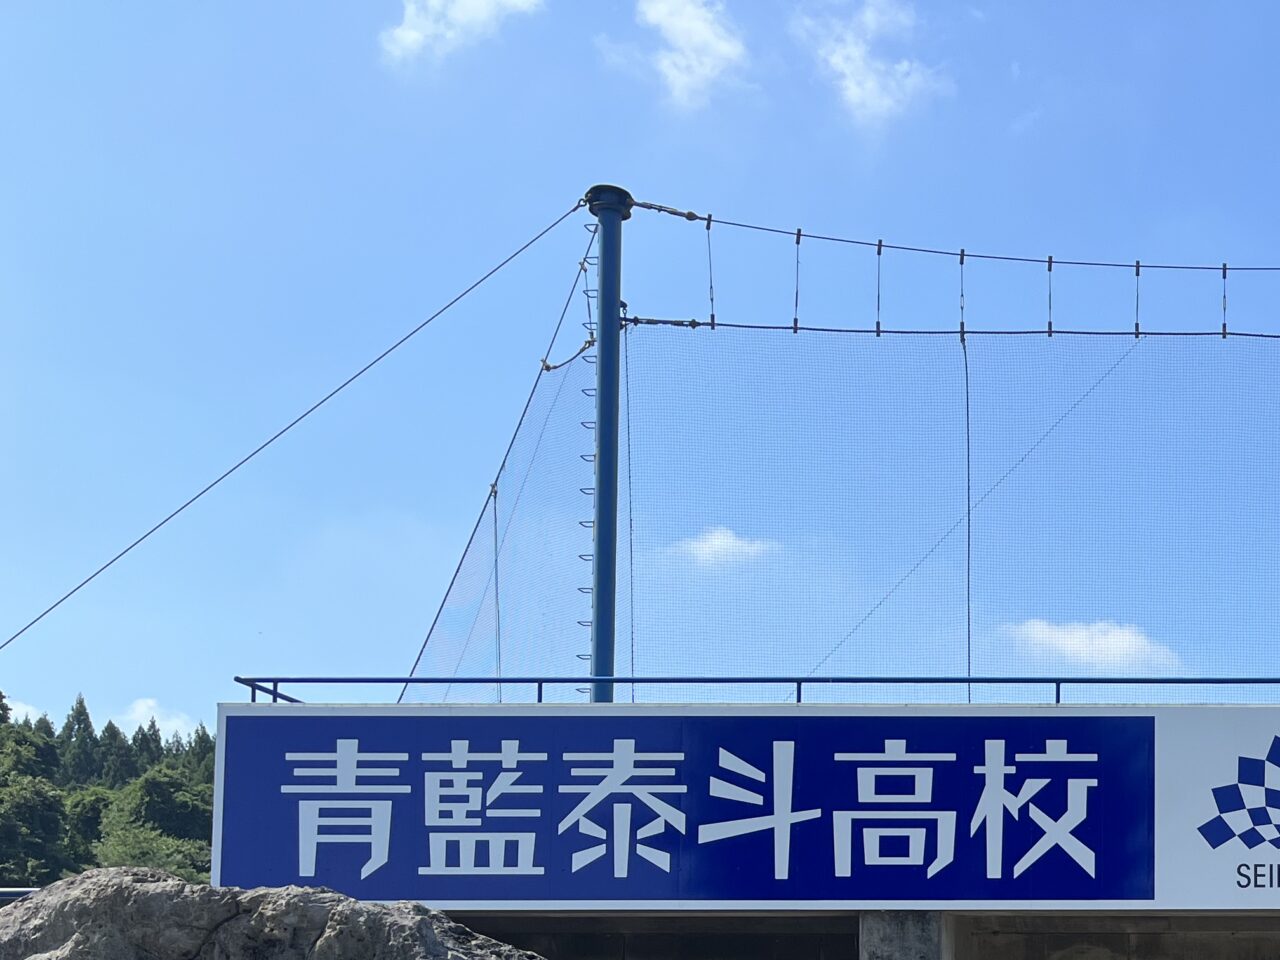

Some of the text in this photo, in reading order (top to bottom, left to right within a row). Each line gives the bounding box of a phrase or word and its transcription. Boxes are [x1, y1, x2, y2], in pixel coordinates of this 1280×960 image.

[280, 738, 1099, 881] 青藍泰斗高校
